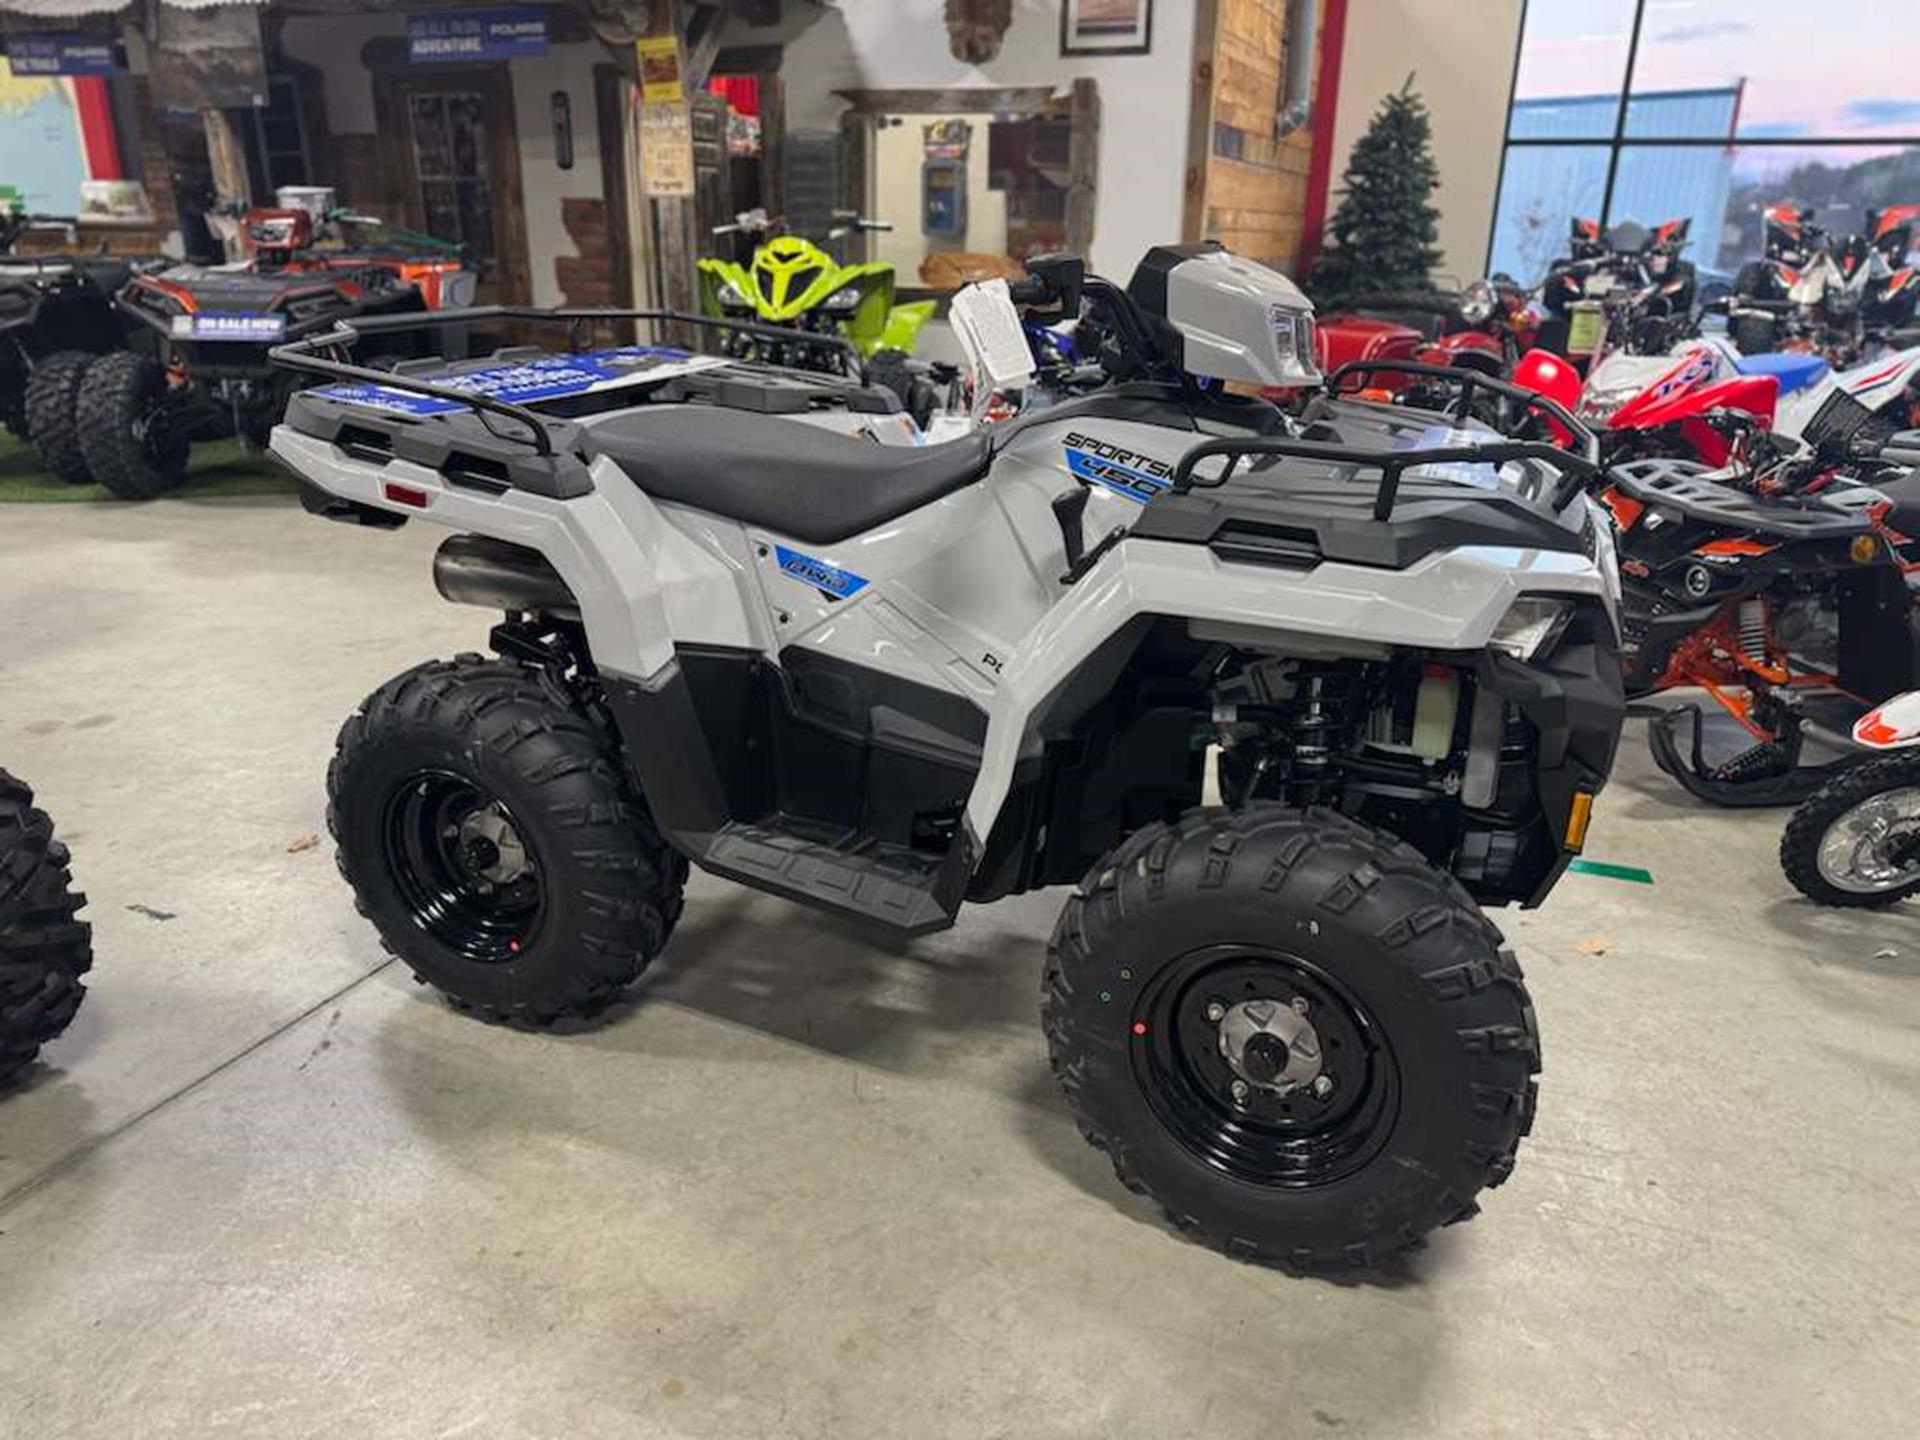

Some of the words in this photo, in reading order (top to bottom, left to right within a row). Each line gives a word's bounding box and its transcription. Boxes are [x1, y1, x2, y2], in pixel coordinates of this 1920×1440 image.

[489, 22, 546, 36] POLARIS
[218, 317, 250, 330] SALE
[252, 318, 280, 331] NOW
[1081, 458, 1163, 496] 450
